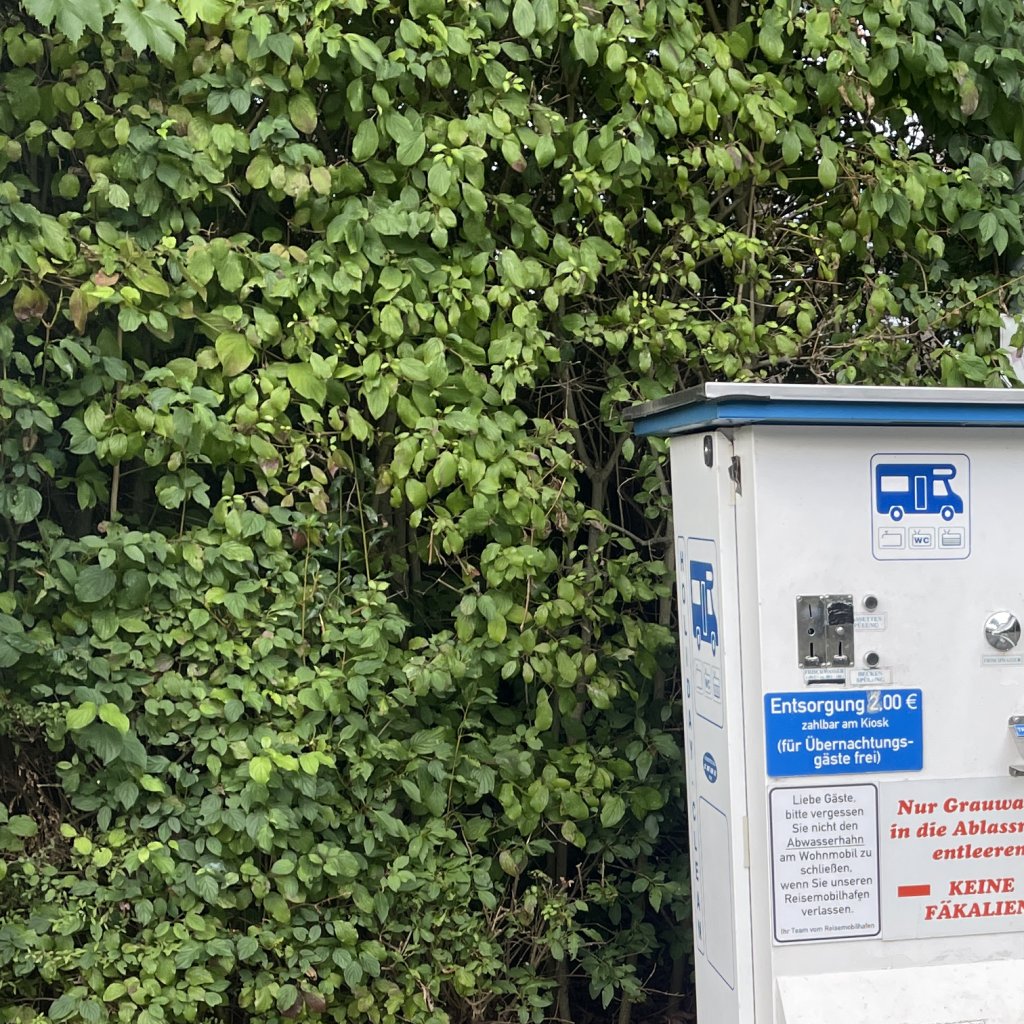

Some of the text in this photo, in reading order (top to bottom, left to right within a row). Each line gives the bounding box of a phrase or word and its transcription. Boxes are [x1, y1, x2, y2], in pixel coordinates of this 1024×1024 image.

[914, 536, 930, 544] WC
[770, 697, 865, 717] Entsorgung
[905, 693, 918, 710] €
[801, 717, 890, 731] zahlbar am Kiosk
[777, 735, 914, 754] (für Übernachtungs-
[813, 751, 881, 769] gäste frei)
[792, 795, 822, 806] Liebe
[897, 799, 938, 816] Nur
[785, 808, 864, 820] bitte vergessen
[792, 822, 858, 834] Sie nicht den
[890, 823, 911, 840] in
[916, 821, 947, 838] die
[786, 835, 864, 848] Abwasserhahn
[779, 849, 872, 863] am Wohnmobil zu
[780, 876, 873, 891] wenn Sie unseren
[948, 877, 1015, 896] KEINE
[784, 890, 870, 904] Reisemobilhafen
[791, 927, 809, 935] Team
